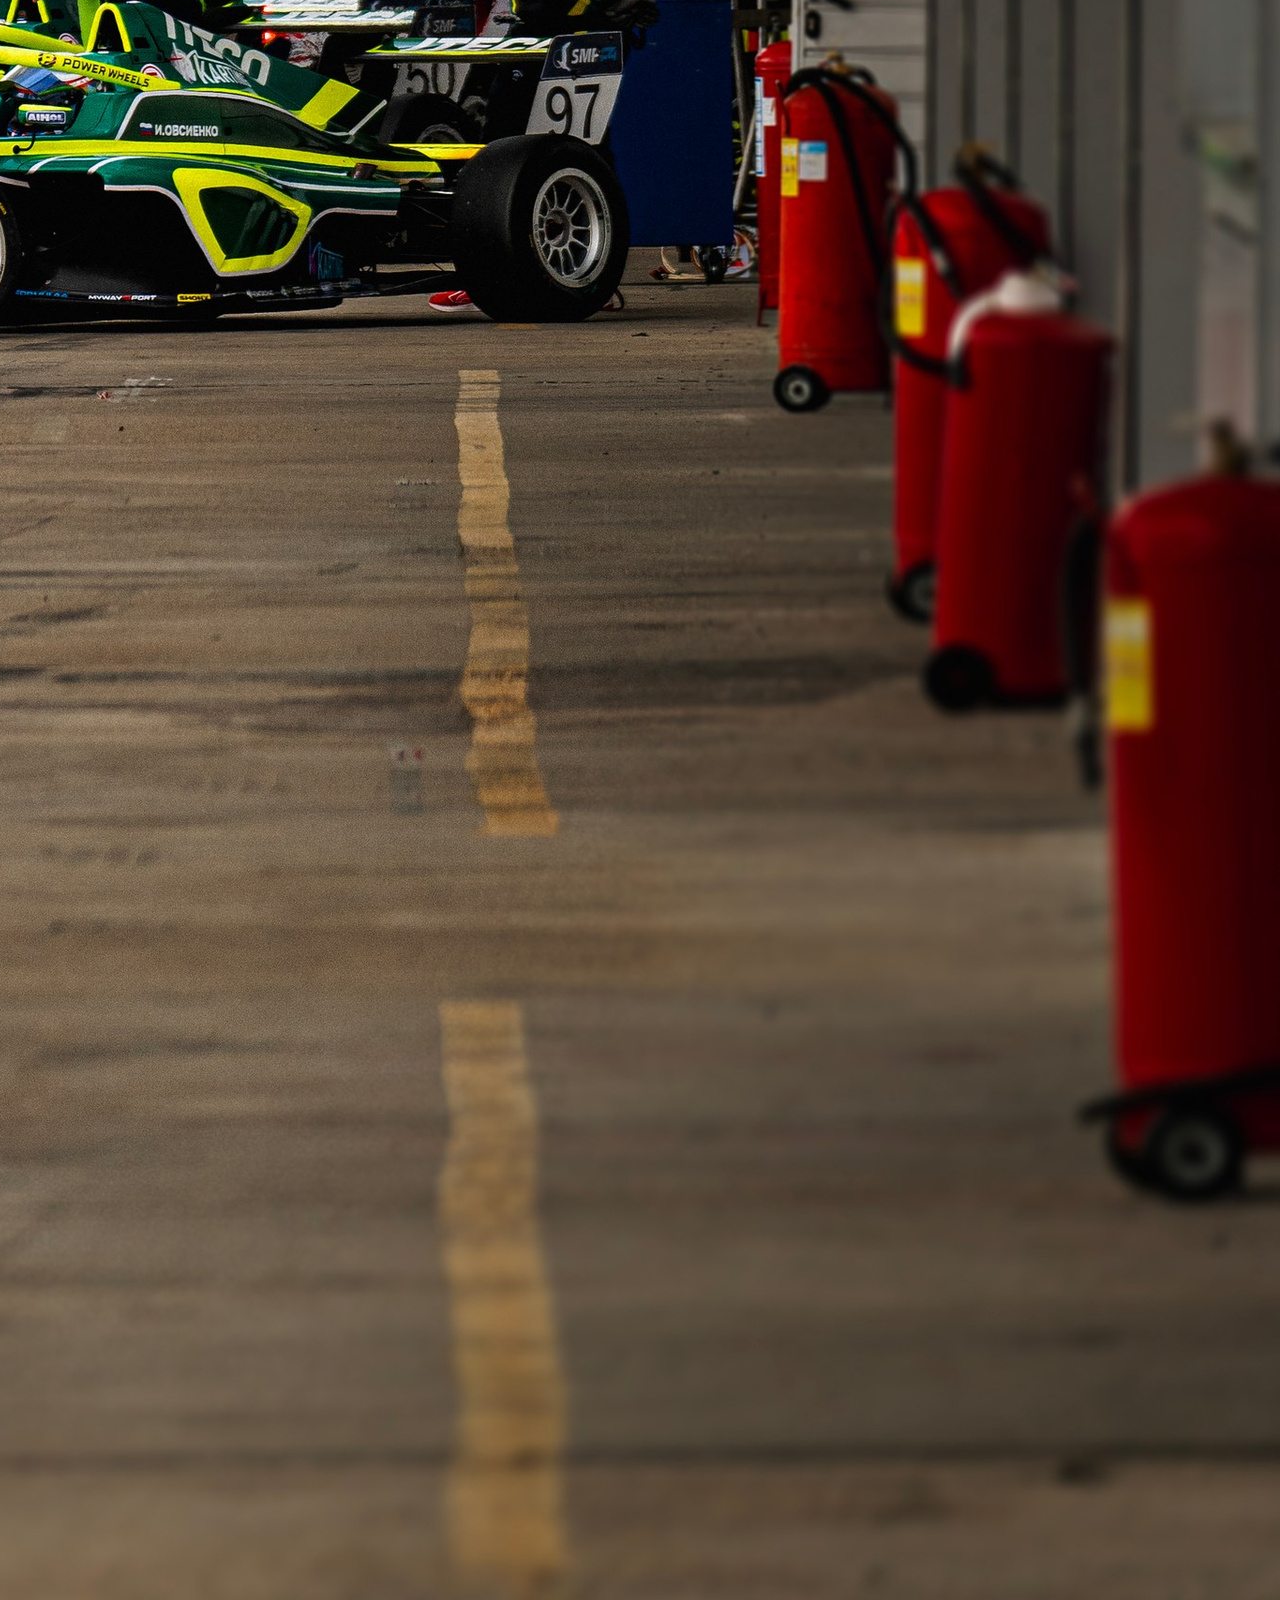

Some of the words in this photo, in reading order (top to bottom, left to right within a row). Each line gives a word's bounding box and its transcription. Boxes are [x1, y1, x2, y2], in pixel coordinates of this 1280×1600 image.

[62, 58, 106, 78] POWER
[107, 67, 150, 88] WHEELS
[407, 62, 455, 99] 50
[545, 83, 600, 139] 97
[154, 123, 219, 138] И.ОВСИЕНКО
